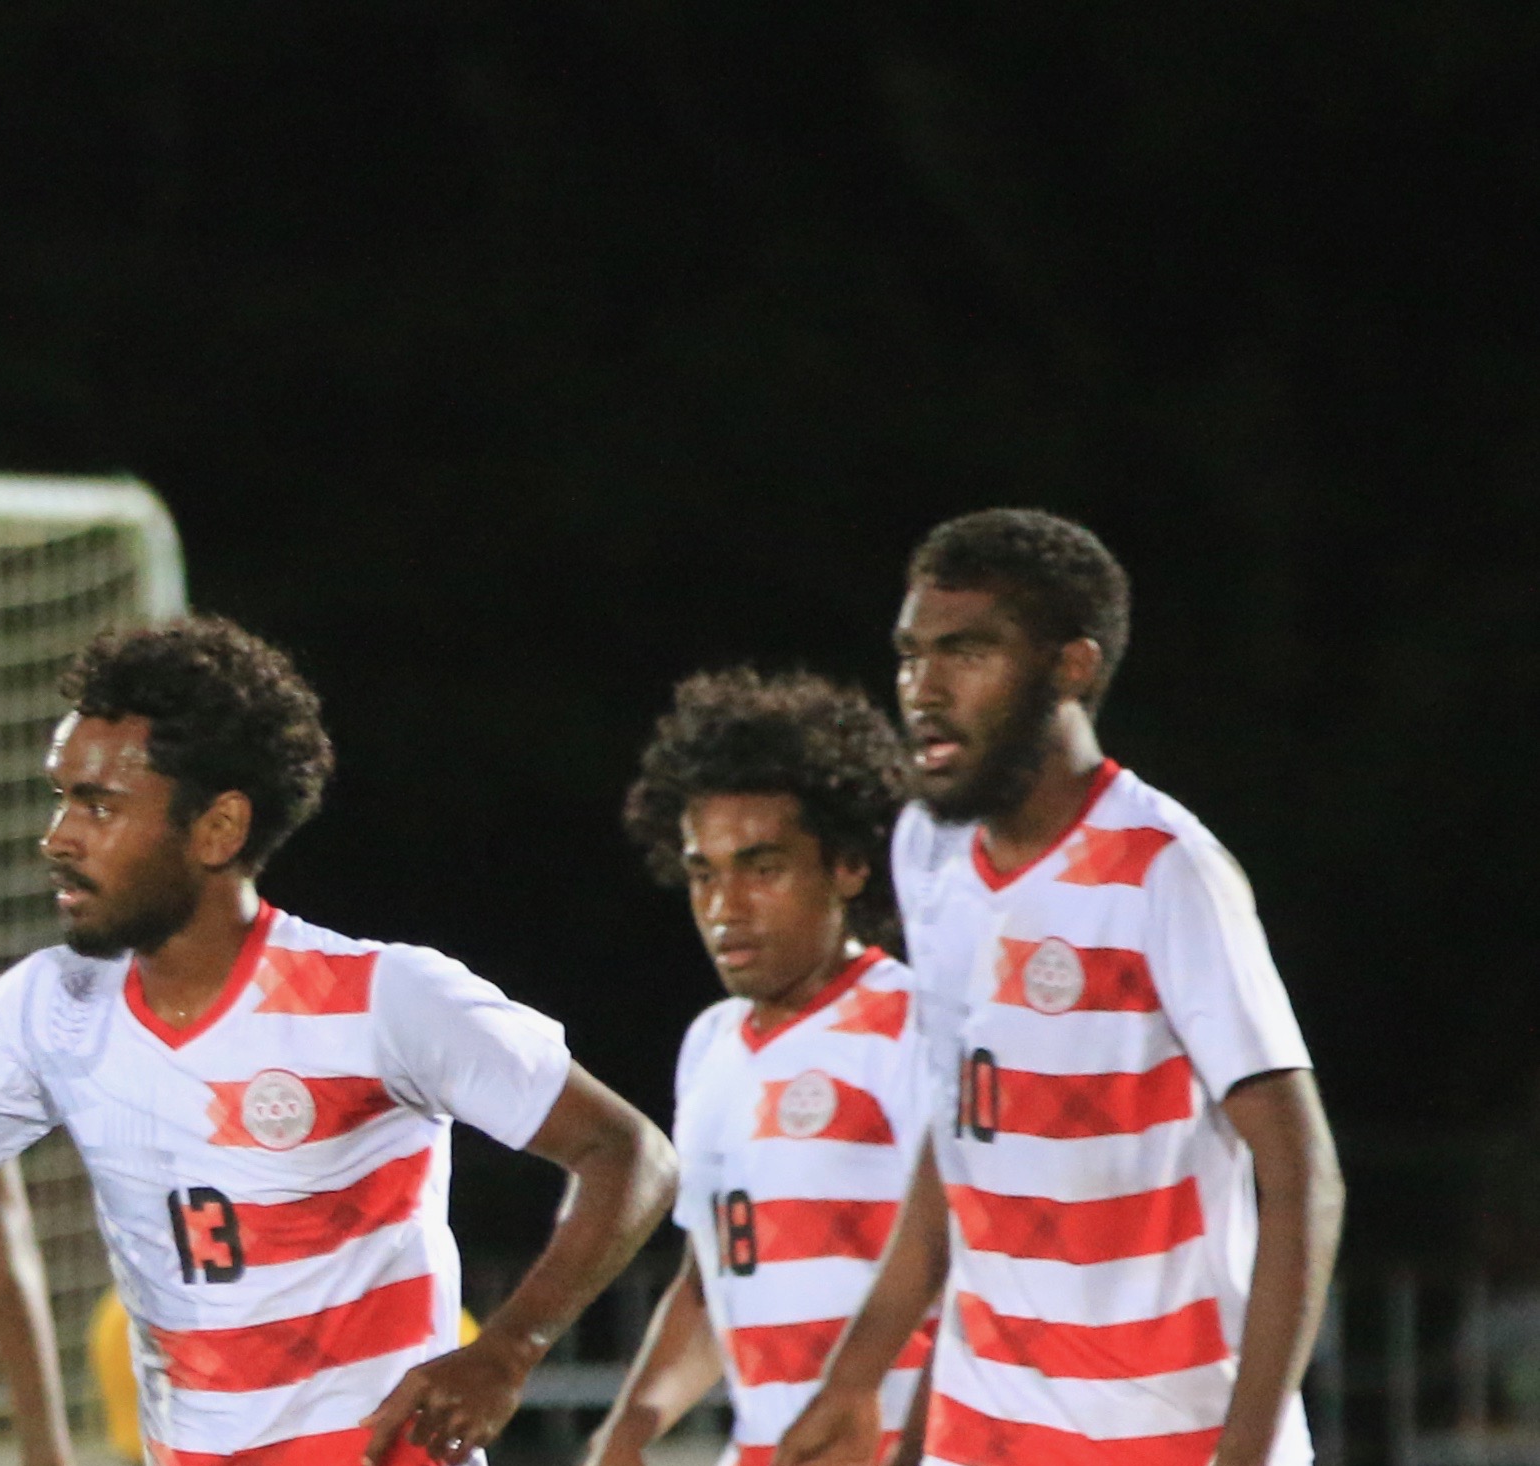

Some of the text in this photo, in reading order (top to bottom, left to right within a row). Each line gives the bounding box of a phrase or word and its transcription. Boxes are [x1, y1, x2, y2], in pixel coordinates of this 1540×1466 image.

[955, 1046, 997, 1144] 10
[167, 1186, 245, 1285] 13
[711, 1188, 758, 1277] 18
